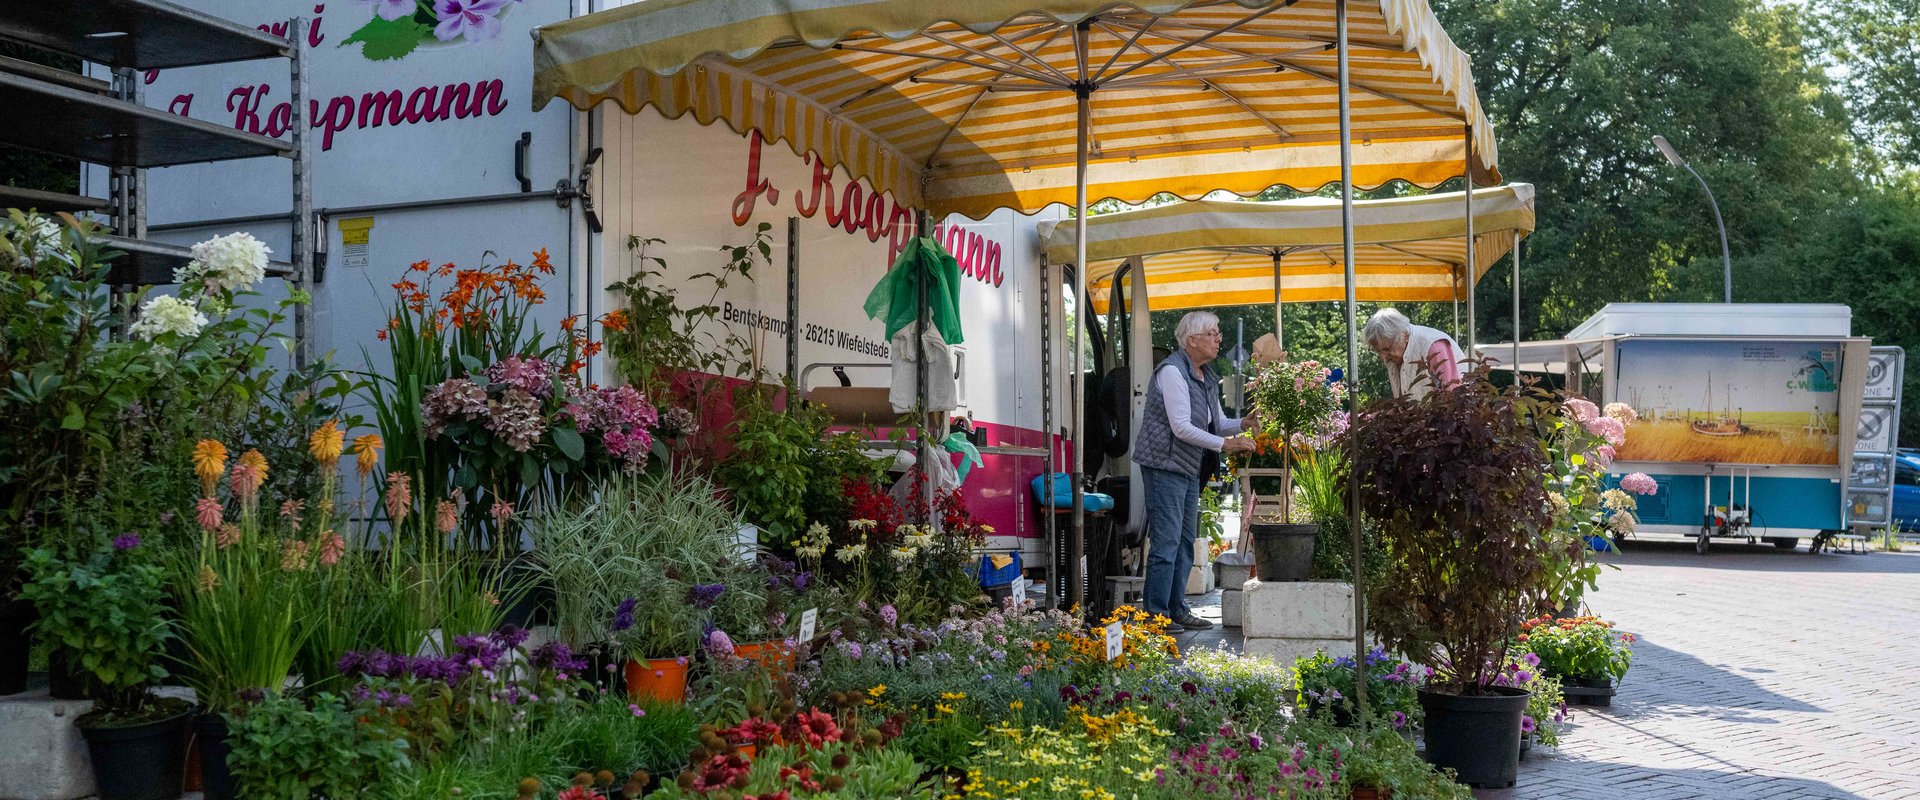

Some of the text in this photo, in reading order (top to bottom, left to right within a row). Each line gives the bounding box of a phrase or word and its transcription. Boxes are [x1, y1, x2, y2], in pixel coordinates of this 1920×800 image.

[723, 301, 788, 339] Bentskamp
[805, 322, 835, 346] 26215
[837, 330, 889, 359] Wiefelstede
[1857, 442, 1878, 450] ONE
